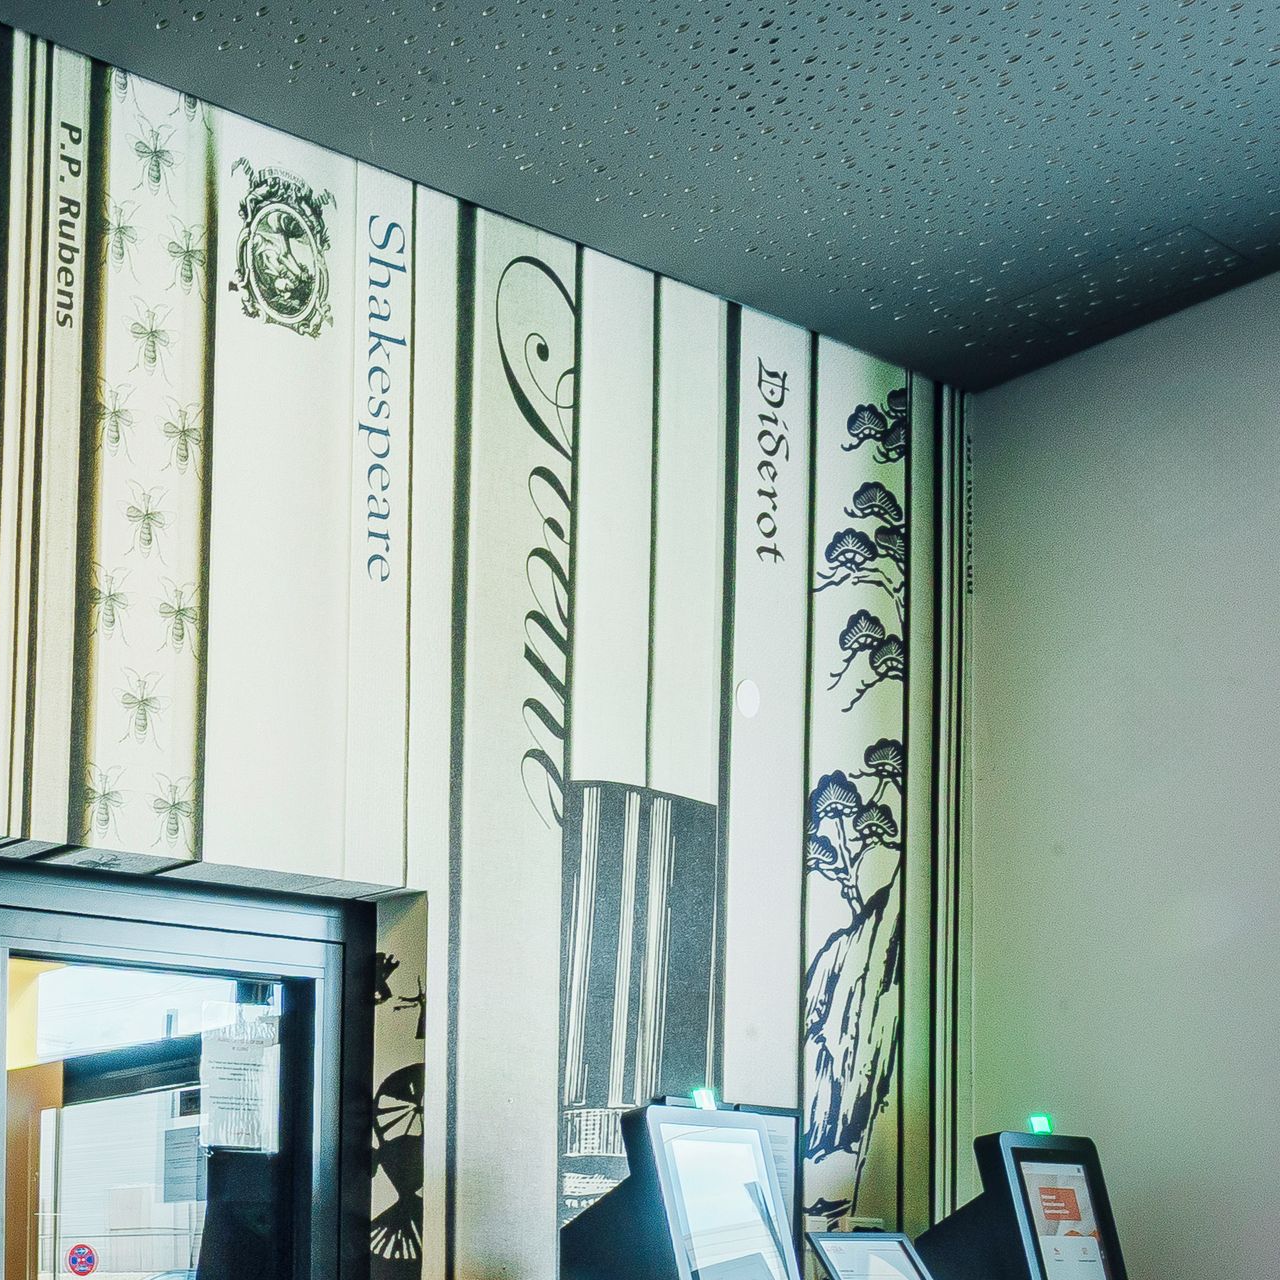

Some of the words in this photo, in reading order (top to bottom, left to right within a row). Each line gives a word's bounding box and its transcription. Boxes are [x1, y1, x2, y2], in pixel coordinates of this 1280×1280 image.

[57, 119, 85, 188] P.P.
[53, 196, 81, 329] Rubens
[356, 212, 408, 584] Shakespeare
[755, 356, 795, 566] Diderot
